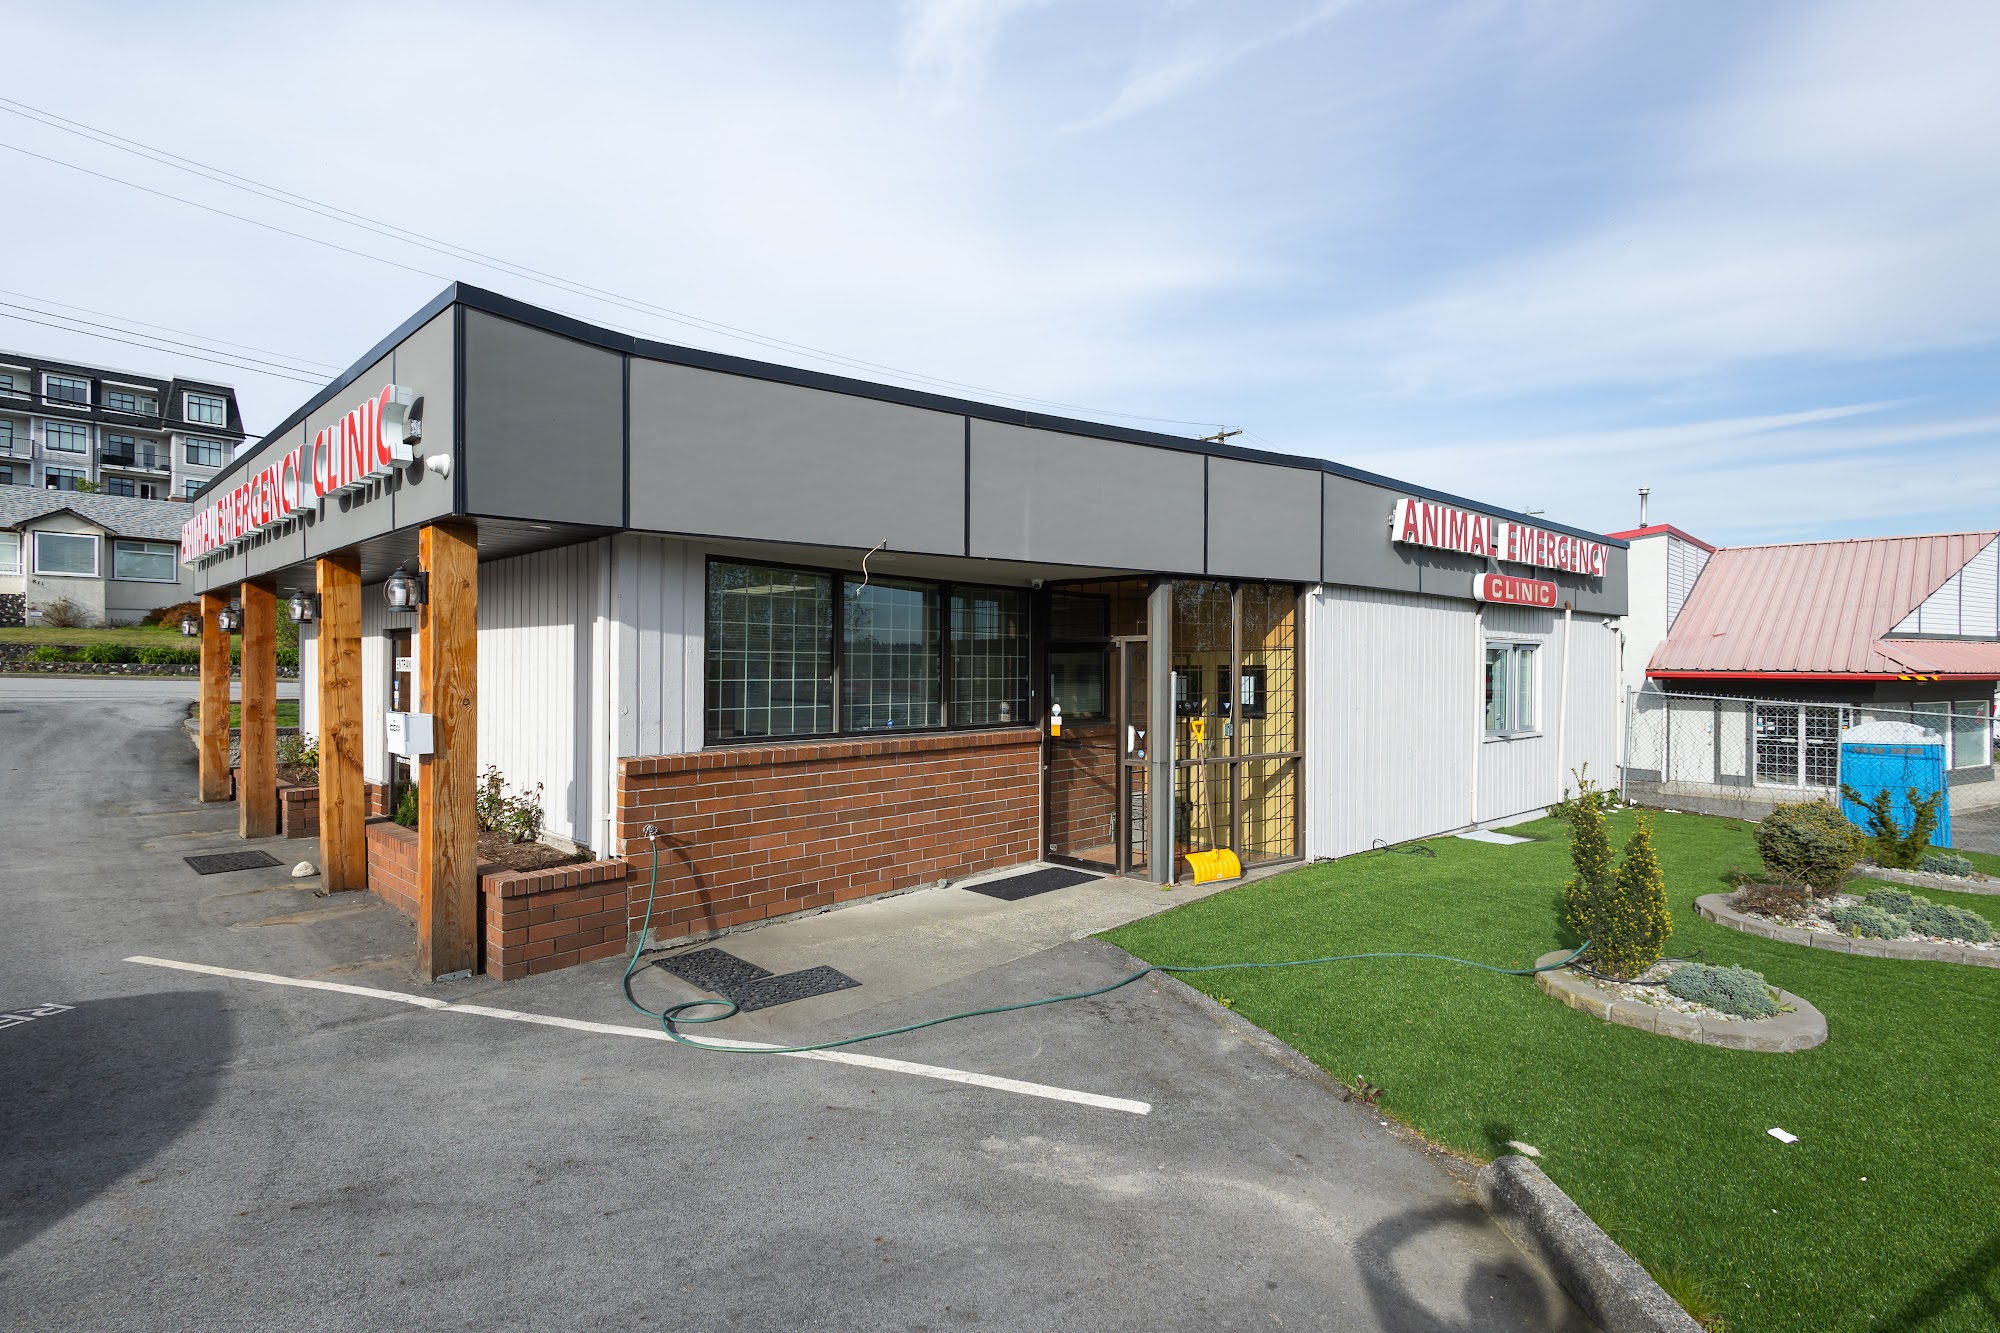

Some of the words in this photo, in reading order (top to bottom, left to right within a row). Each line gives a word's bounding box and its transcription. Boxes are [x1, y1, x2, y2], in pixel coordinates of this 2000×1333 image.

[182, 506, 216, 564] ANIMAL
[217, 444, 304, 546] EMERGENCY
[312, 384, 395, 498] CLINIC
[1402, 498, 1498, 557] ANIMAL
[1507, 523, 1610, 577] EMERGENCY
[1491, 578, 1550, 603] CLINIC
